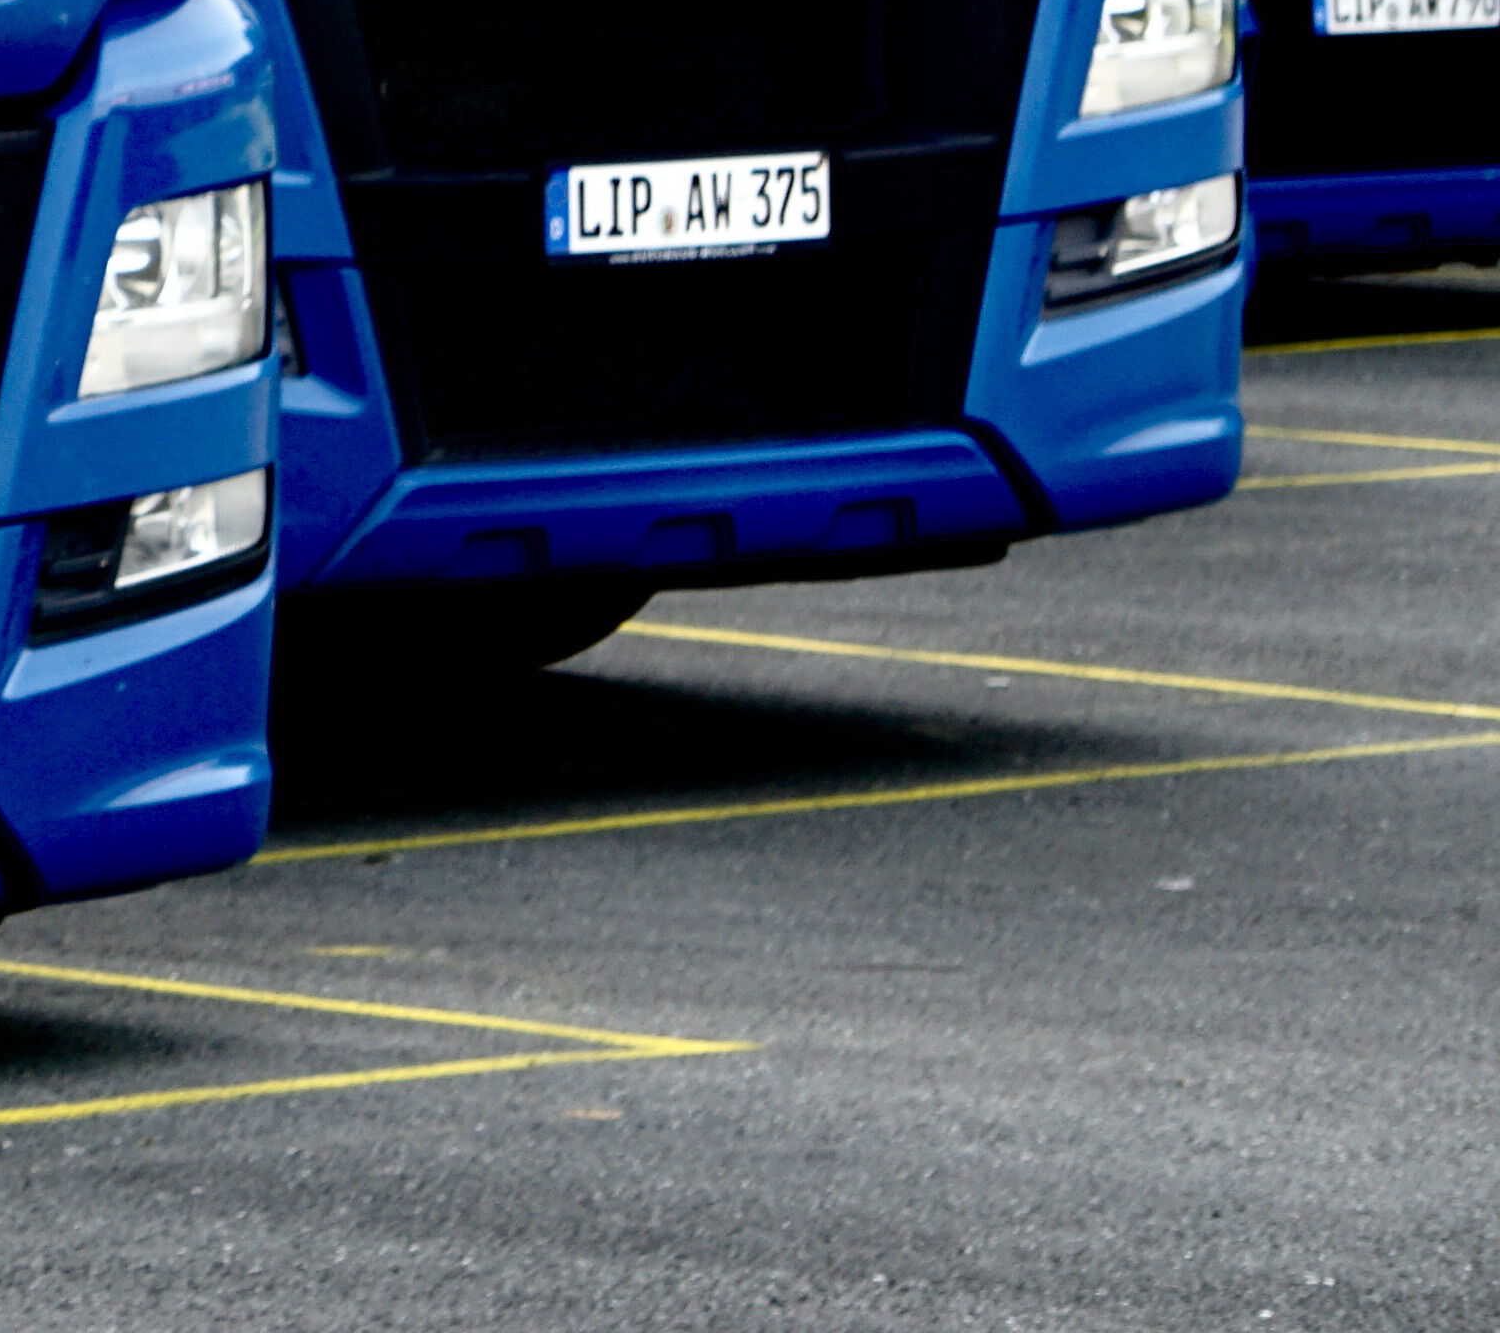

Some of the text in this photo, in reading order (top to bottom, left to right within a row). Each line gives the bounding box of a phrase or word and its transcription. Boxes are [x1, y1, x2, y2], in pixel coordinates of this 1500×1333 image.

[578, 165, 822, 239] LIP AW 375
